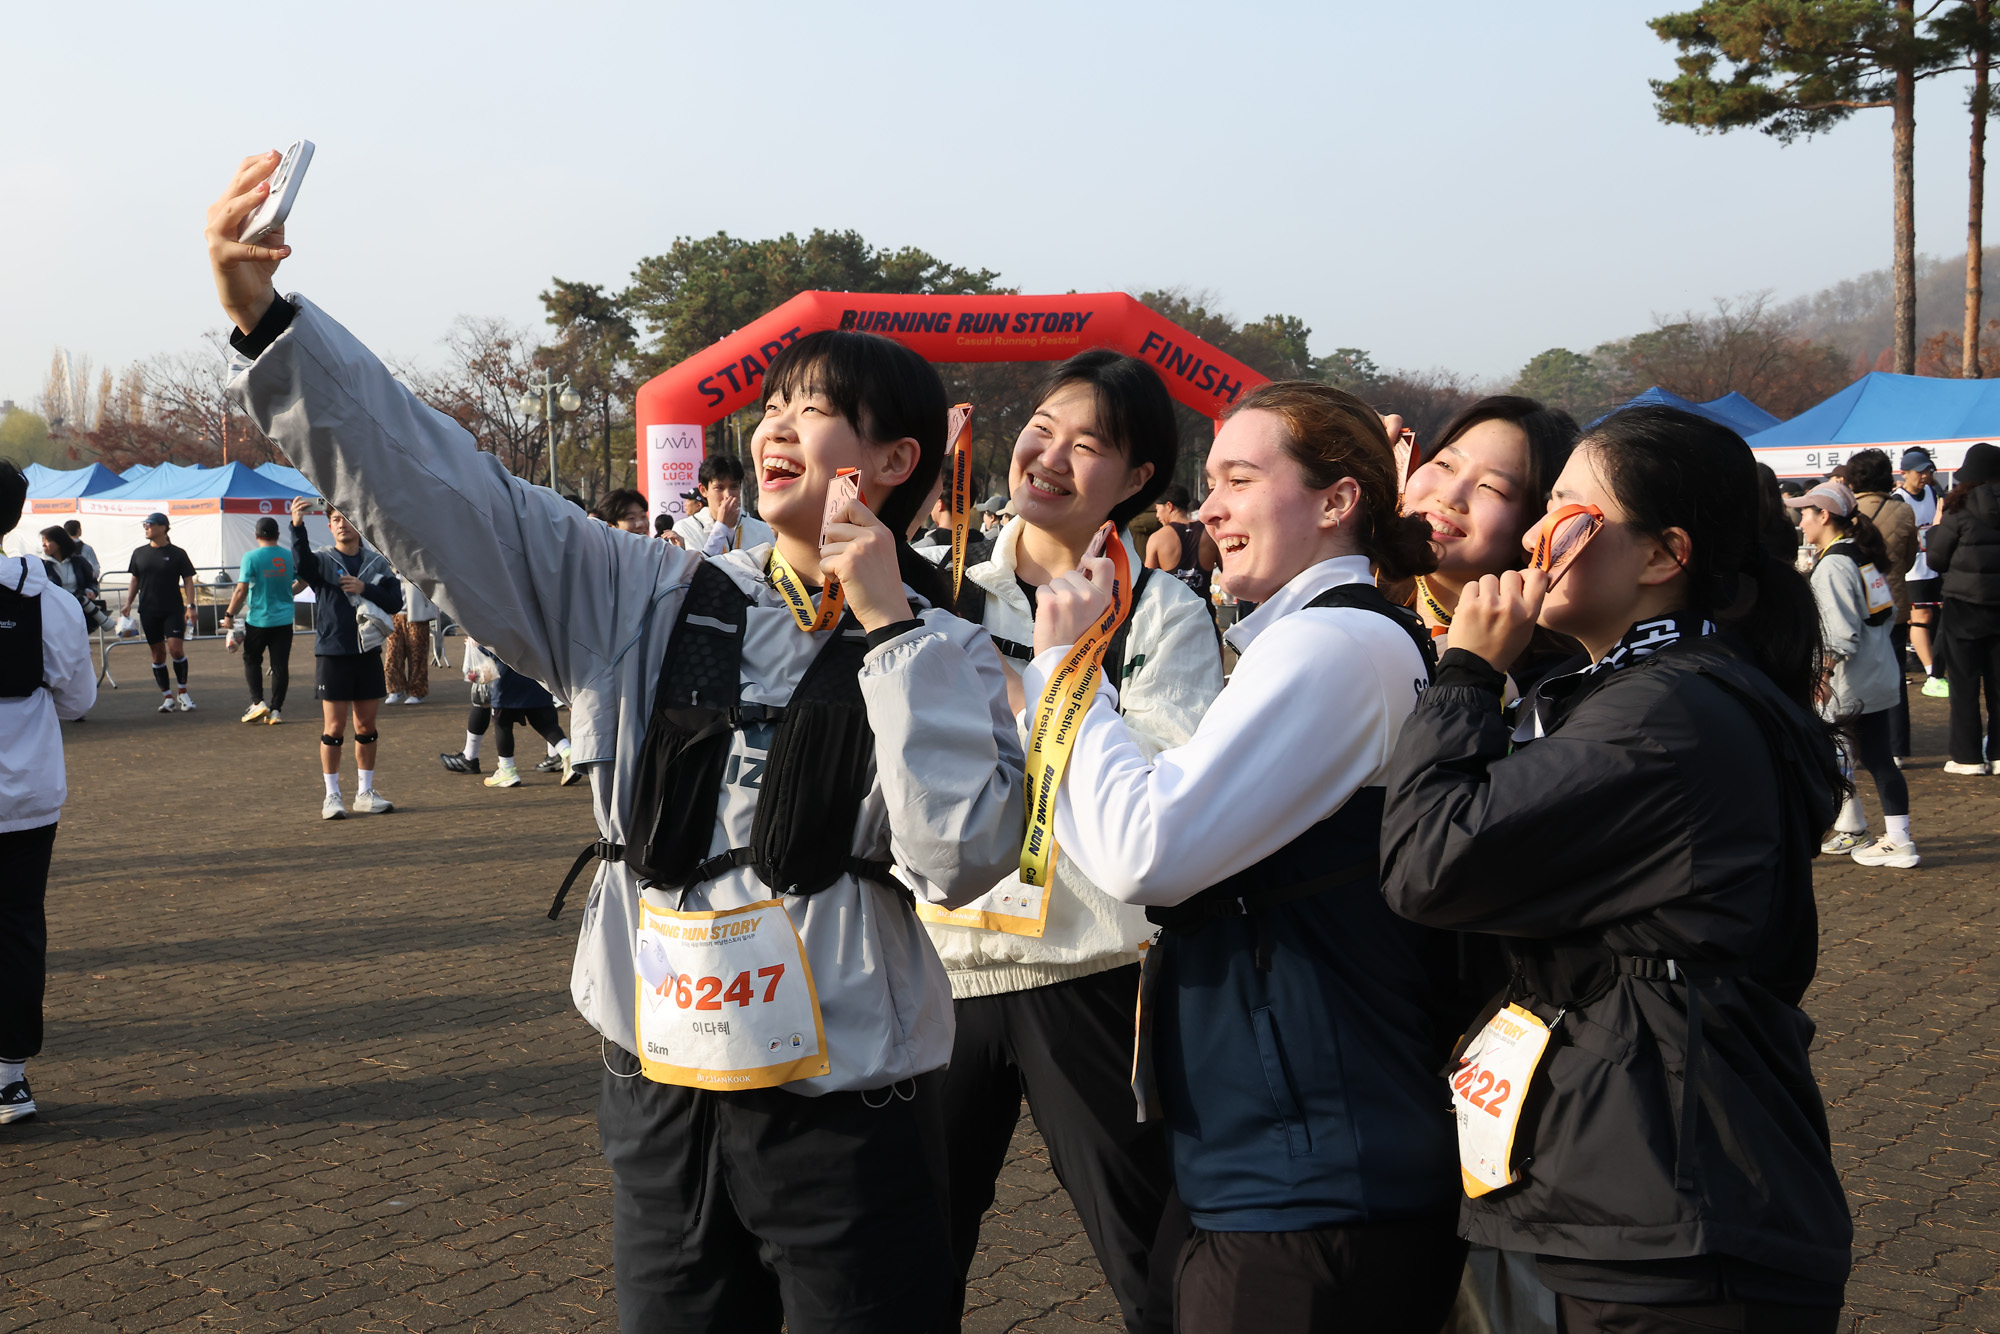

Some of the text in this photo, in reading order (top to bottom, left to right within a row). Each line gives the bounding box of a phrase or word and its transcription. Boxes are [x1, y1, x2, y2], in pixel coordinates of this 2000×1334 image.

[838, 309, 1094, 334] BURNING RUN STORY
[956, 335, 1080, 348] Casual Running Festival
[1138, 330, 1243, 405] FINISH
[662, 462, 694, 471] GOOD
[955, 450, 965, 515] BURNING RUN
[955, 523, 964, 555] Casual
[827, 580, 841, 601] UN
[795, 607, 814, 627] RUN
[1072, 661, 1098, 701] Running
[1033, 638, 1097, 753] Casual Running Festival
[1055, 701, 1081, 746] Festival
[1028, 763, 1055, 857] BURNING RUN
[681, 927, 709, 941] RUN
[709, 917, 763, 940] STORY
[692, 1021, 730, 1036] 이다혜
[1494, 1017, 1529, 1041] STORY
[647, 1041, 669, 1056] 5km
